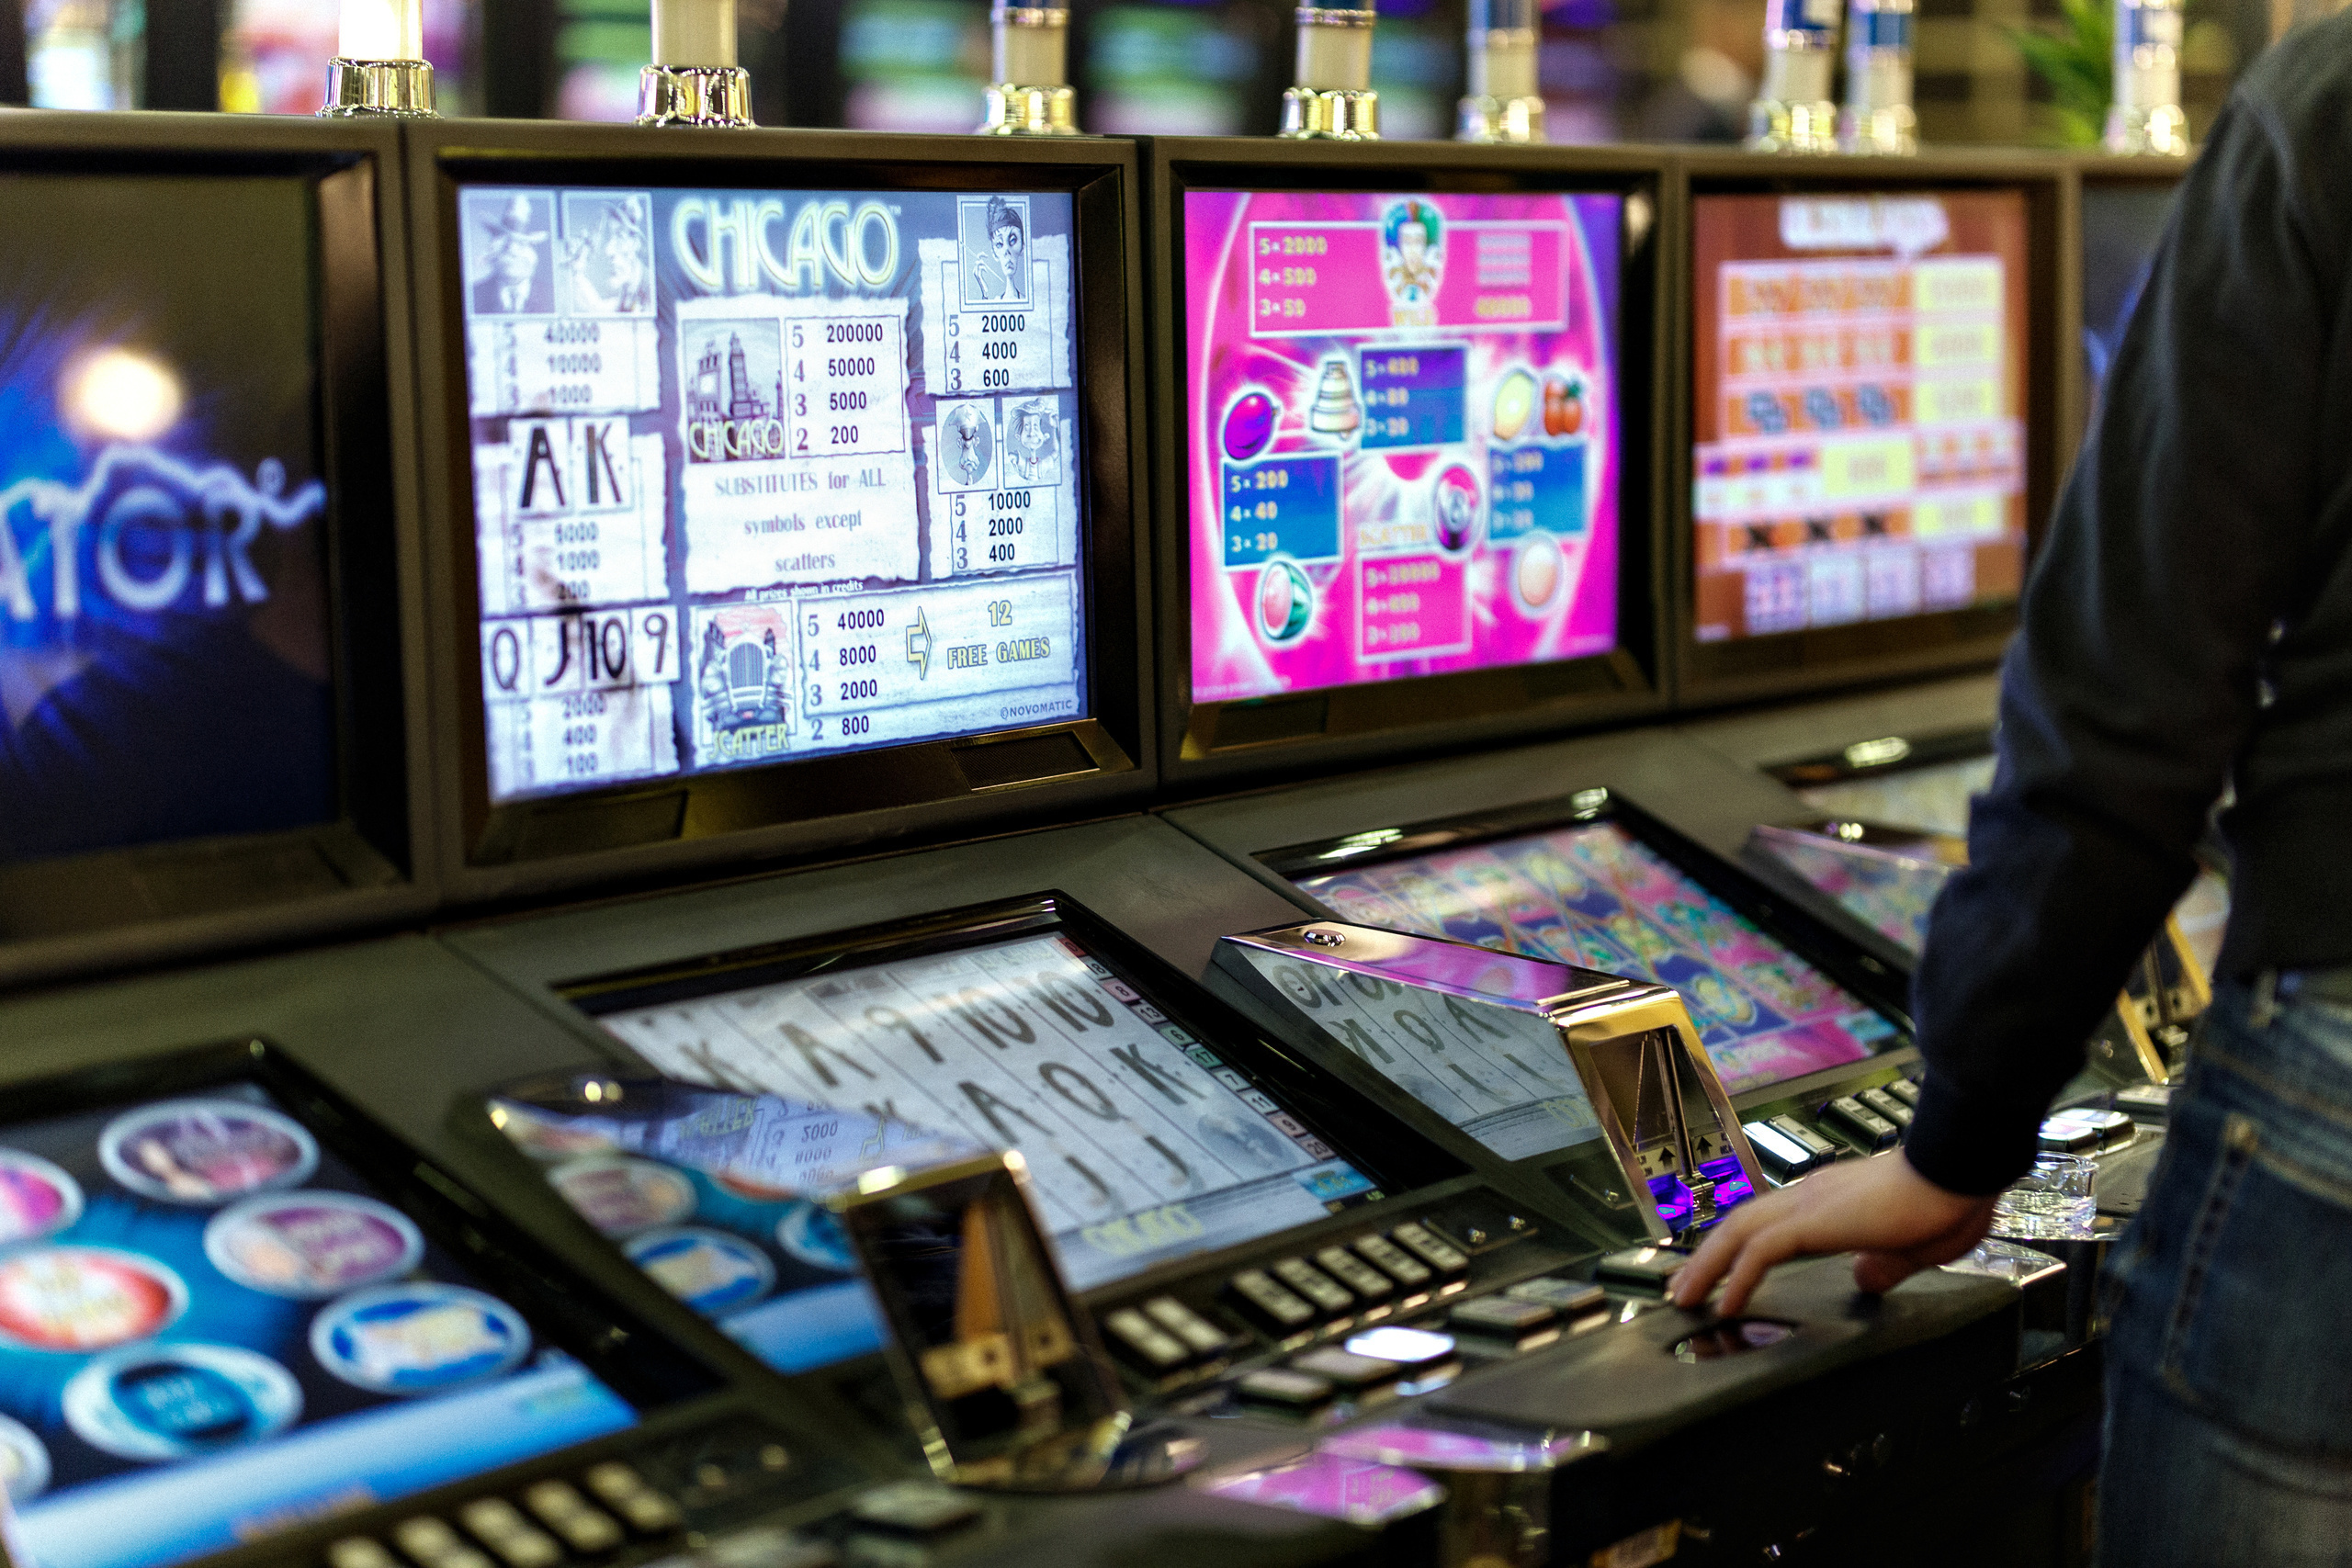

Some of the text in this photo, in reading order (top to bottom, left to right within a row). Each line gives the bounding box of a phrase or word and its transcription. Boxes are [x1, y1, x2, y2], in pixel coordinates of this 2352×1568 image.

[673, 197, 899, 291] CHICAGO
[792, 323, 883, 348] 5 200000
[949, 314, 1025, 337] 5 20000
[949, 341, 1017, 363] 4 4000
[794, 356, 875, 382] 4 50000
[950, 367, 1010, 390] 3 600
[795, 391, 867, 416] 3 5000
[689, 418, 784, 457] CHICAGO
[797, 425, 859, 451] 2 200
[521, 423, 622, 508] A K
[715, 468, 886, 496] SUBSTITUTES for ALL
[955, 491, 1031, 516] 5 10000
[744, 509, 862, 539] symbols except
[956, 516, 1023, 543] 4 2000
[775, 553, 836, 572] scatters
[956, 543, 1015, 570] 3 400
[832, 579, 864, 592] credits
[807, 608, 885, 637] 5 40000
[988, 600, 1012, 627] 12
[492, 614, 668, 692] Q J 10 9
[808, 644, 876, 672] 4 8000
[947, 637, 1050, 670] FREE GAMES
[810, 679, 877, 706] 3 2000
[811, 715, 870, 741] 2 800
[708, 723, 789, 760] SCATTER
[1114, 986, 1130, 997] 8
[1140, 1007, 1160, 1020] 13
[779, 1021, 876, 1087] A
[864, 1005, 944, 1064] 9
[933, 987, 1036, 1049] 10
[1014, 970, 1114, 1033] 10
[1170, 1030, 1184, 1041] 6
[1195, 1051, 1215, 1064] 17
[1225, 1074, 1238, 1085] 7
[957, 1043, 1208, 1145] A Q K
[1251, 1096, 1272, 1108] 11
